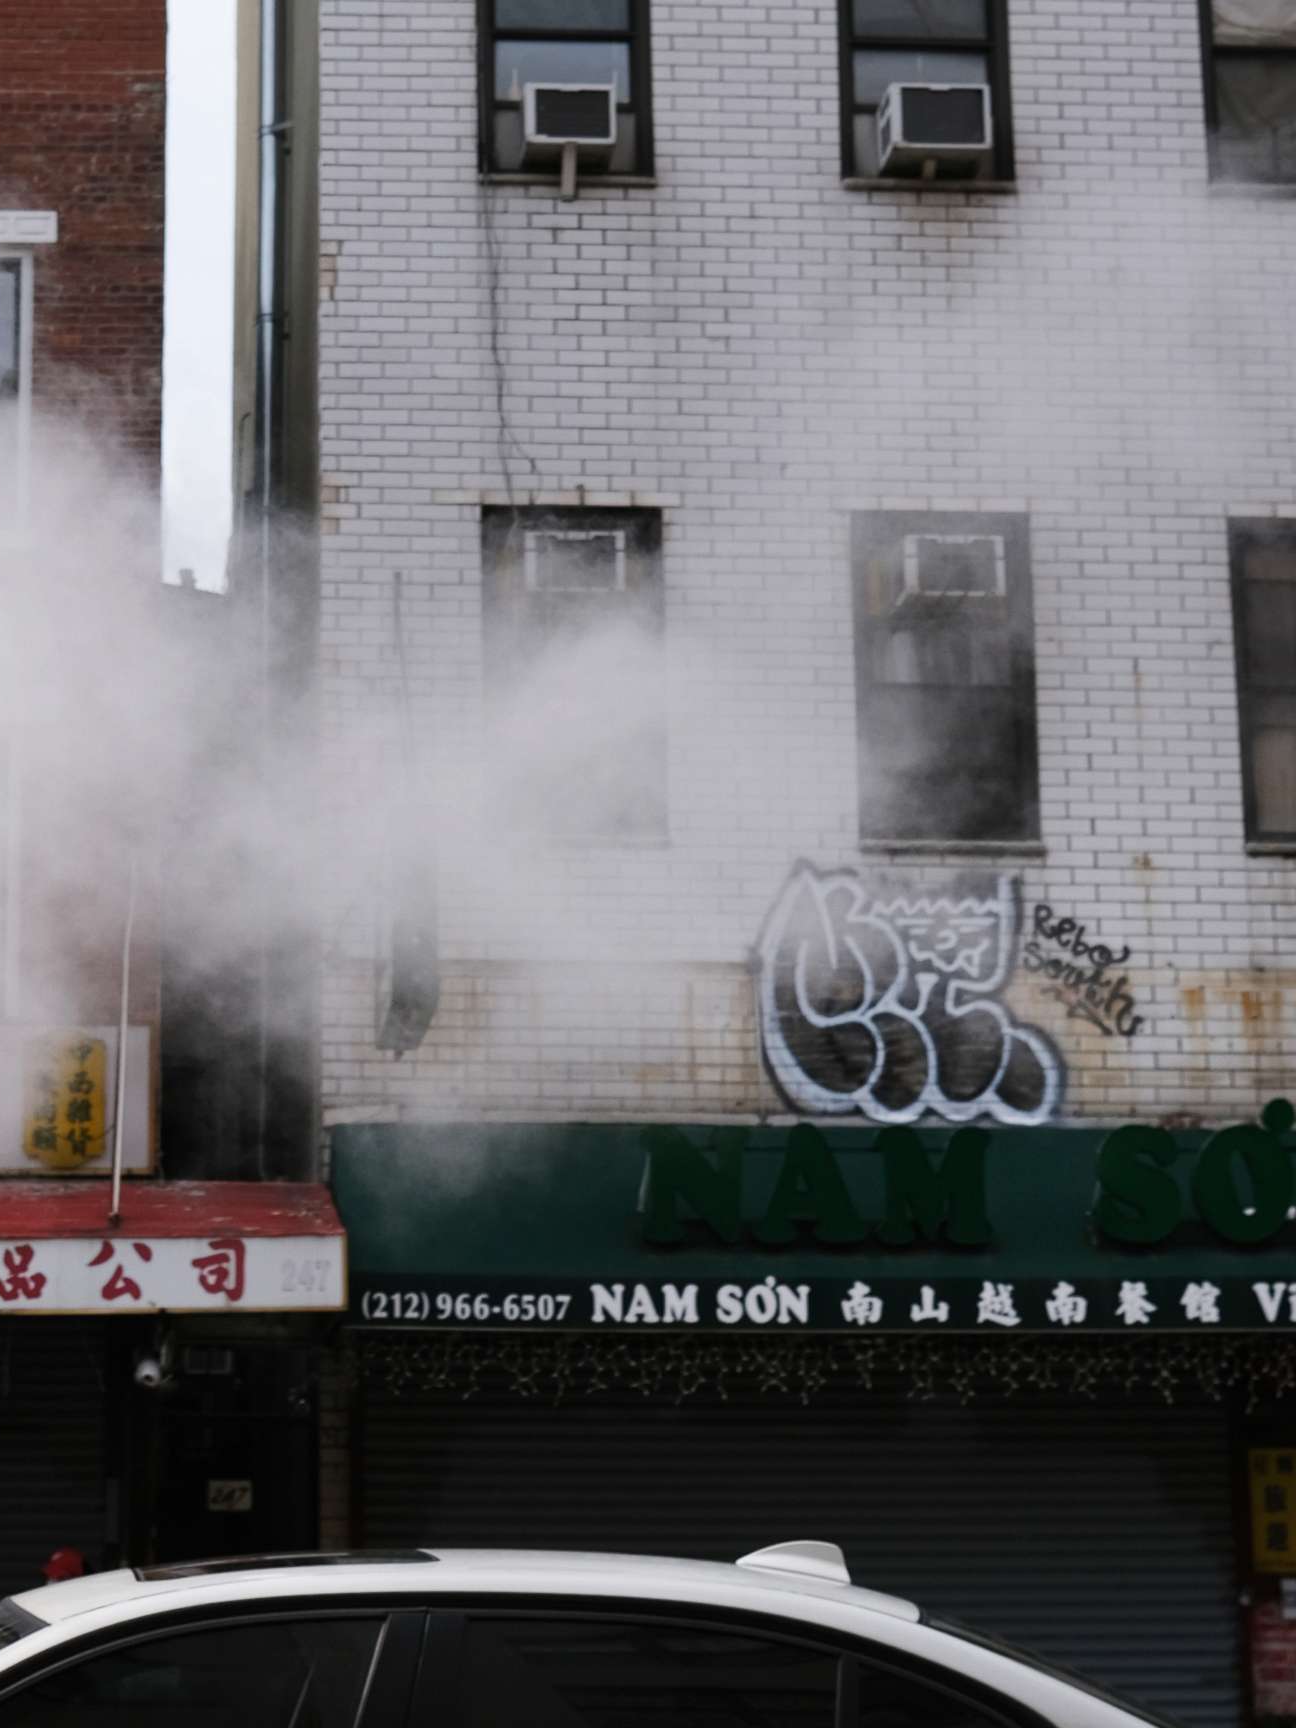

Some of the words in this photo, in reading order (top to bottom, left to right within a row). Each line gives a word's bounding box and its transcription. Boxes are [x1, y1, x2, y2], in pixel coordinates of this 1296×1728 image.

[642, 1123, 994, 1246] NAM
[280, 1260, 332, 1293] 247
[435, 1292, 572, 1321] 966-6507
[590, 1284, 699, 1323] NAM
